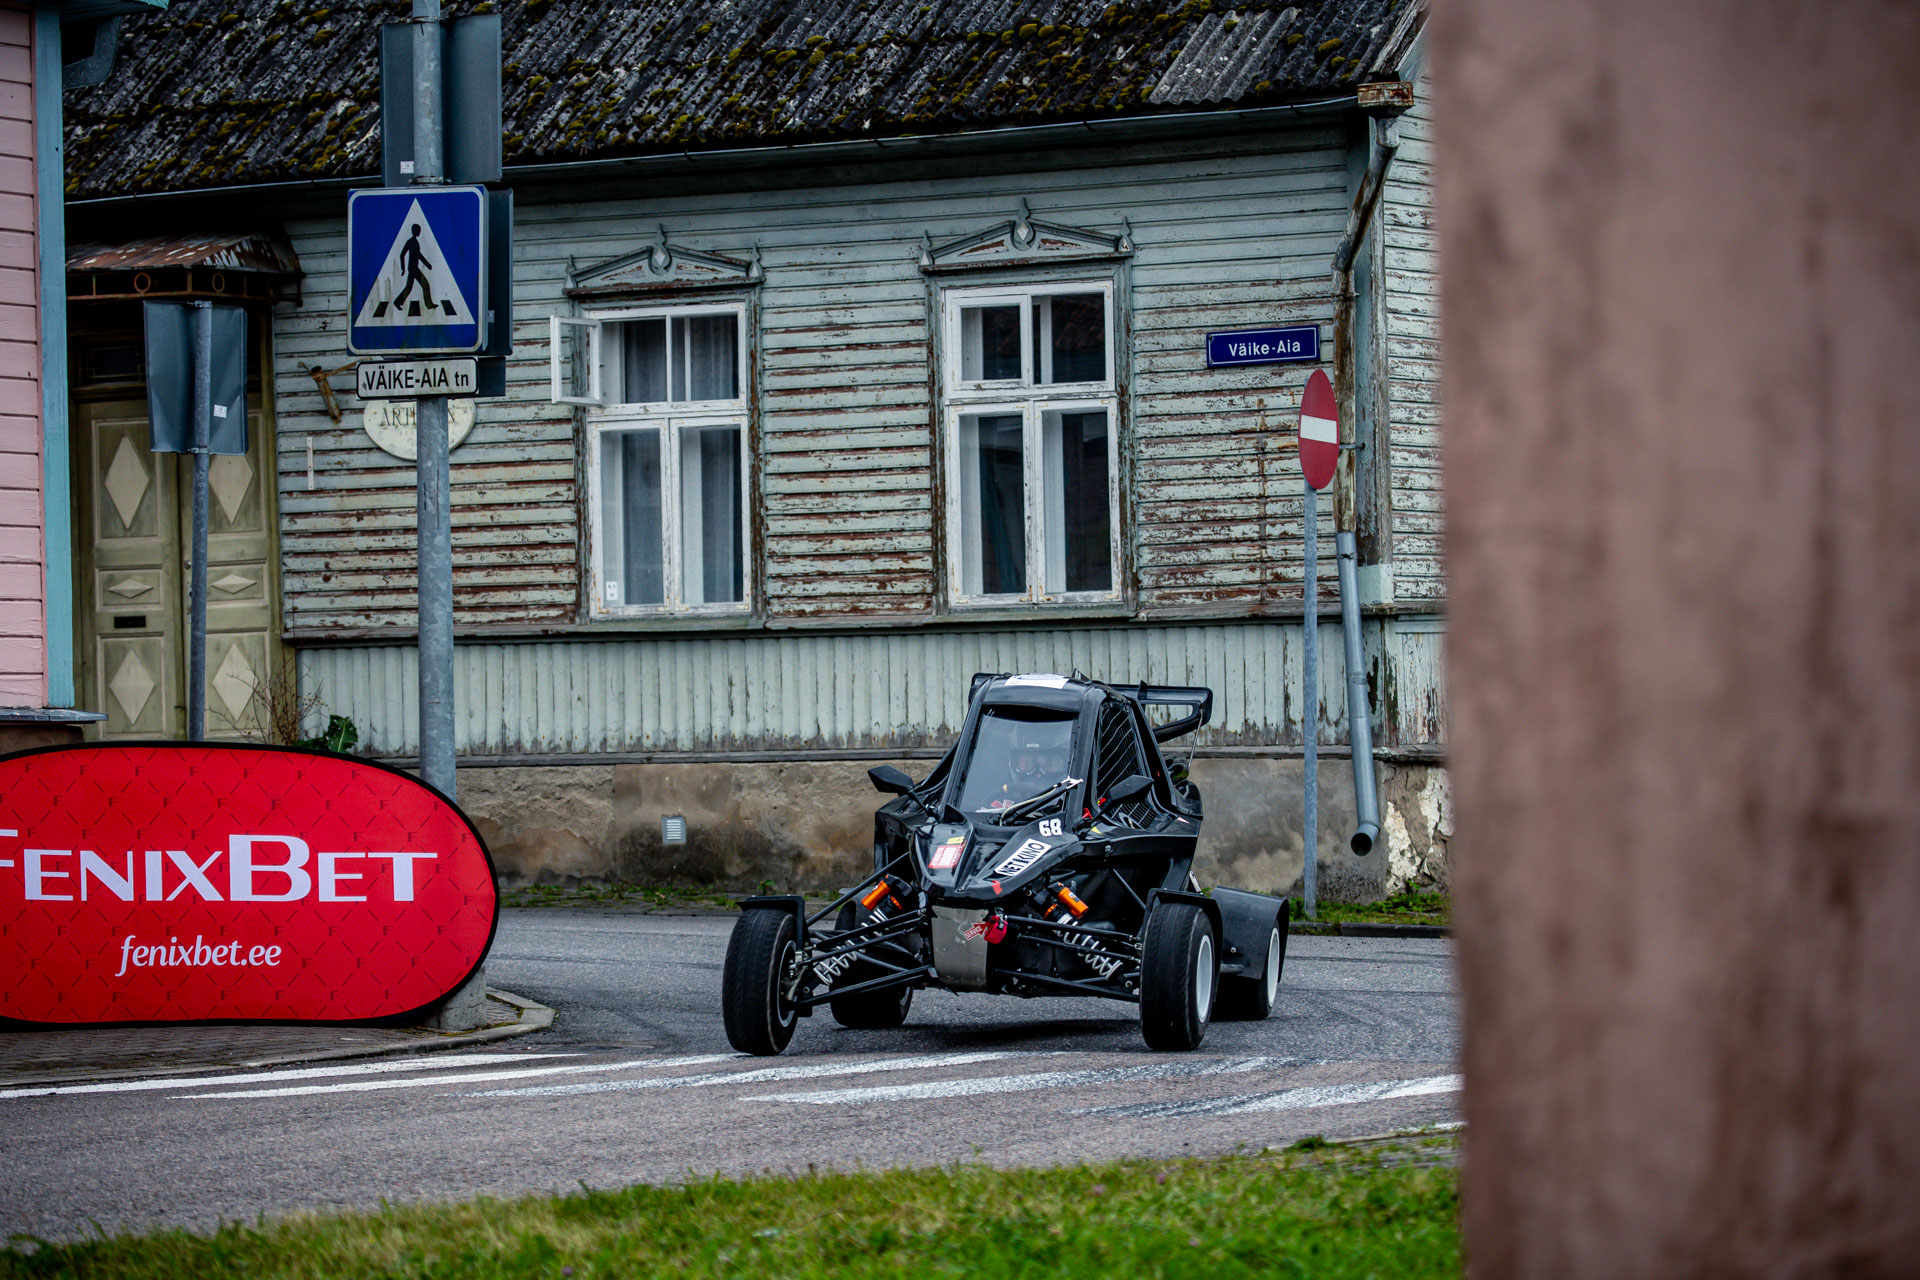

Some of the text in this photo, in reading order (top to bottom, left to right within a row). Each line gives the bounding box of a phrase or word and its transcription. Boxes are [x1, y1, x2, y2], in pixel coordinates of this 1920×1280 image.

[1228, 339, 1301, 357] Väike-Aia
[365, 365, 469, 391] VÄIKE-AIA tn
[1038, 818, 1063, 837] 68
[115, 934, 282, 977] fenixbet.ee
